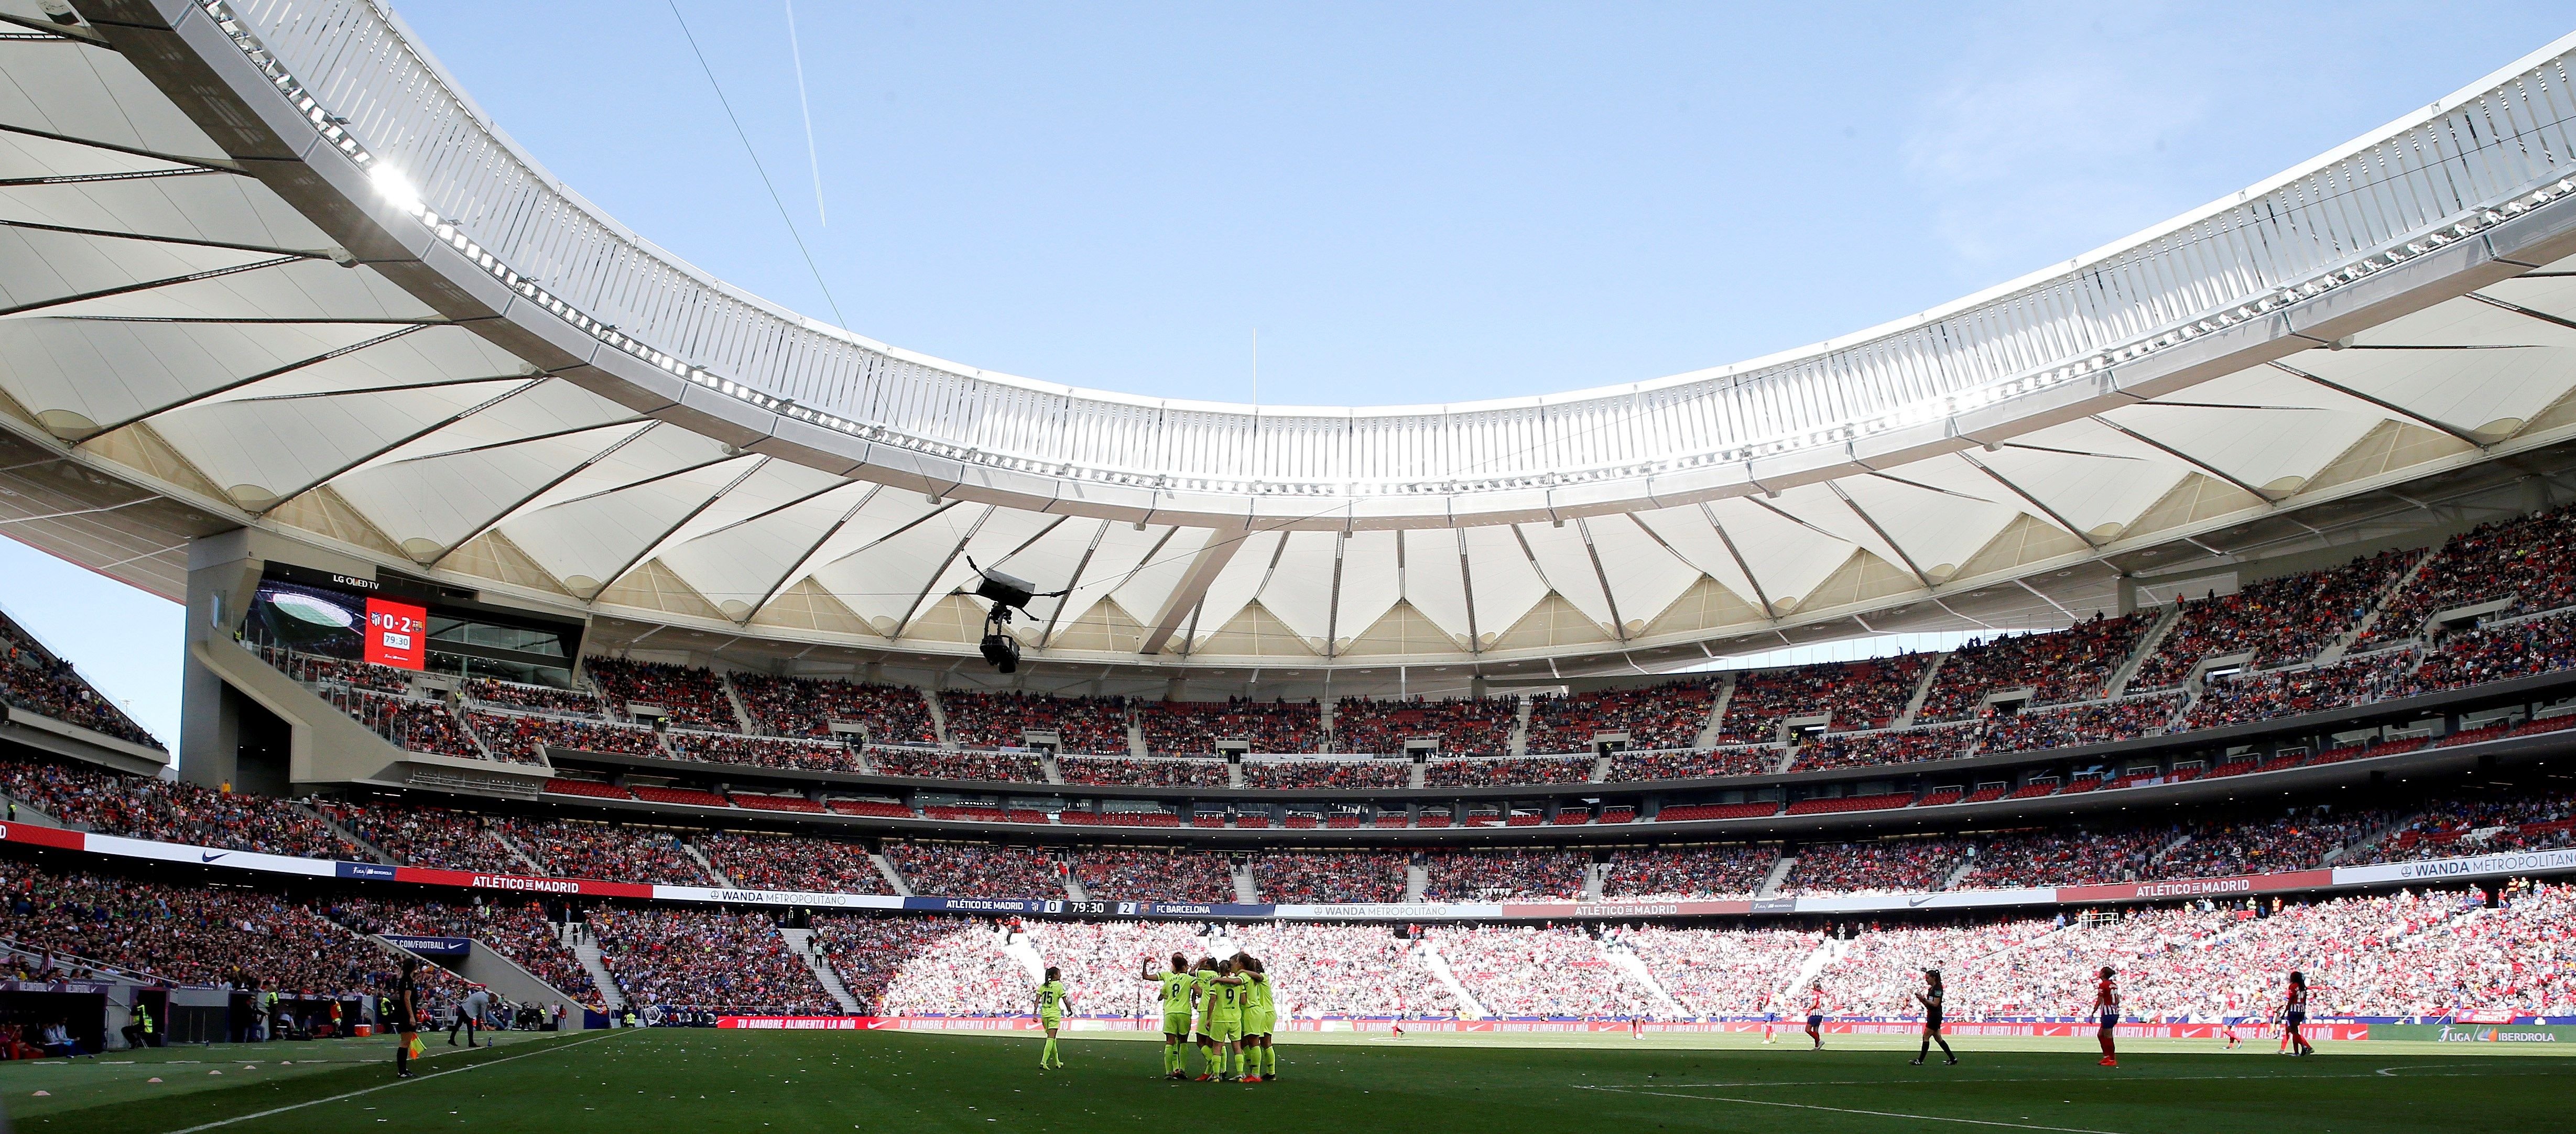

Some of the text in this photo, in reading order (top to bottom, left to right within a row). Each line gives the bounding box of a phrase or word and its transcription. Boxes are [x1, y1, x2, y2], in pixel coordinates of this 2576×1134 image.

[333, 574, 379, 590] LG OLED TV
[385, 635, 408, 646] 79:30
[2415, 852, 2576, 877] WANDA METROPOLITAN
[472, 875, 524, 890] ATLÉTICO
[535, 880, 579, 893] MADRID
[2136, 882, 2191, 898] ATLÉTICO
[2202, 879, 2250, 893] MADRID
[722, 890, 846, 906] WANDA METROPOLITANO
[945, 899, 1024, 911] ATLÉTICO DE MADRID
[1049, 901, 1056, 912] 0
[1072, 902, 1104, 913] 79:30
[1123, 903, 1130, 913] 2
[1156, 904, 1211, 914] FC BARCELONA
[1574, 904, 1624, 915] ATLÉTICO
[1634, 905, 1677, 915] MADRID
[1325, 907, 1447, 916] WANDA METROPOLITANO
[1172, 983, 1180, 998] 8
[1042, 991, 1053, 1005] 15
[1226, 988, 1234, 1005] 9
[737, 1018, 856, 1030] TU HAMBRE ALIMENTA LA MÍA
[899, 1019, 1014, 1030] TU HAMBRE ALIMENTA LA MÍA
[1060, 1021, 1068, 1030] TU
[1142, 1021, 1152, 1031] LA
[1356, 1021, 1457, 1032] TU HAMBR ALIMENTA LA MÍA
[1493, 1022, 1589, 1032] TU HAMBRE ALIMENTA LA MÍA
[1774, 1024, 1787, 1033] AMBRE
[1787, 1024, 1806, 1033] ALIMENT
[1851, 1024, 1857, 1034] TU
[1857, 1024, 1878, 1034] HAMBRE
[1904, 1025, 1911, 1034] LA
[1912, 1023, 1923, 1034] MÍA
[1951, 1024, 2034, 1036] TU HAMBRE ALIMENTA LA MÍA
[2071, 1026, 2079, 1037] TU
[2113, 1027, 2143, 1037] LIMENTA
[2145, 1027, 2154, 1038] LA
[2156, 1025, 2171, 1038] MÍA
[2212, 1027, 2222, 1038] TU
[2302, 1028, 2313, 1039] LA
[2315, 1025, 2333, 1040] MÍA
[2449, 1032, 2555, 1042] LIGA IBERDROLA
